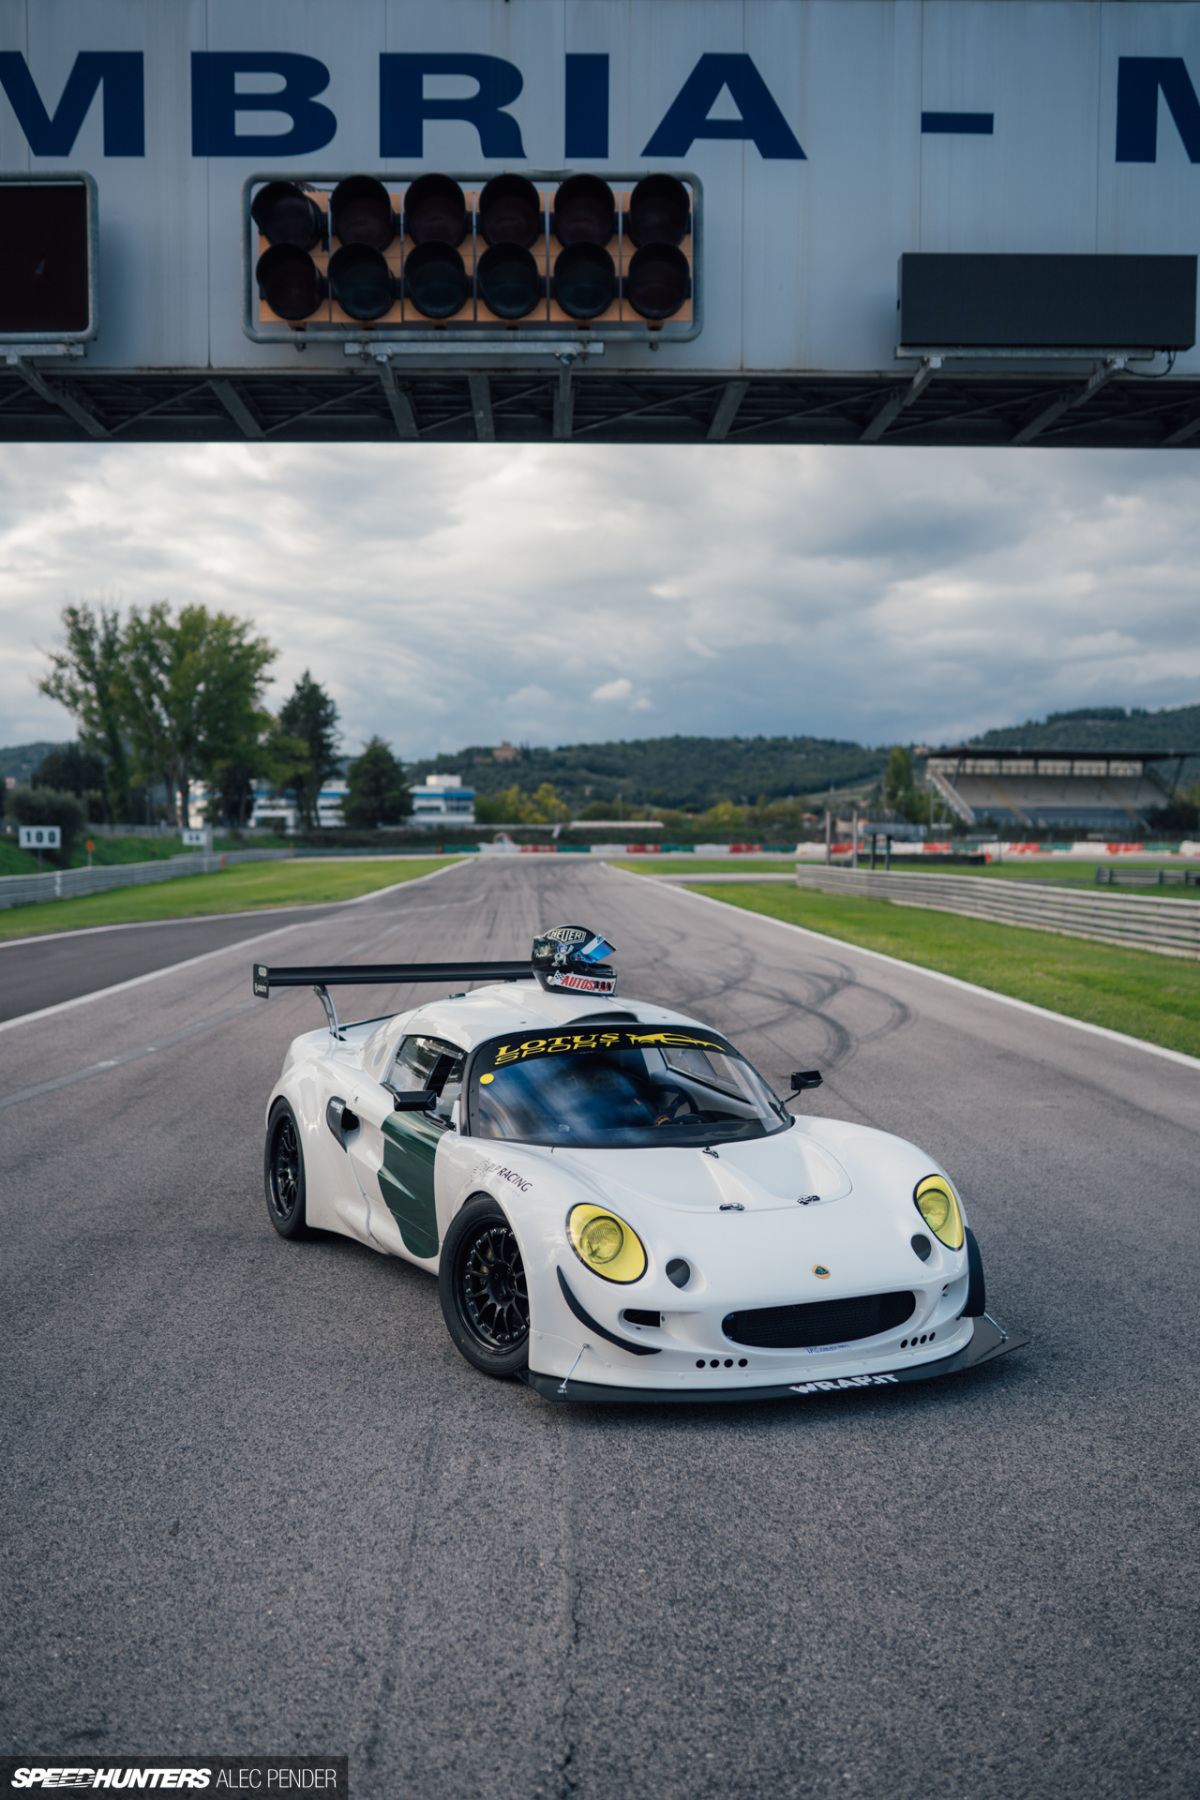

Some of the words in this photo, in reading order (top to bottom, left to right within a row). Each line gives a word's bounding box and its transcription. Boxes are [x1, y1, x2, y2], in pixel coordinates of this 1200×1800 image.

[26, 830, 56, 844] 100
[561, 975, 615, 992] AUTOS
[494, 1040, 621, 1065] SPORT
[495, 1033, 620, 1058] LOTUS
[497, 1167, 533, 1192] RACING
